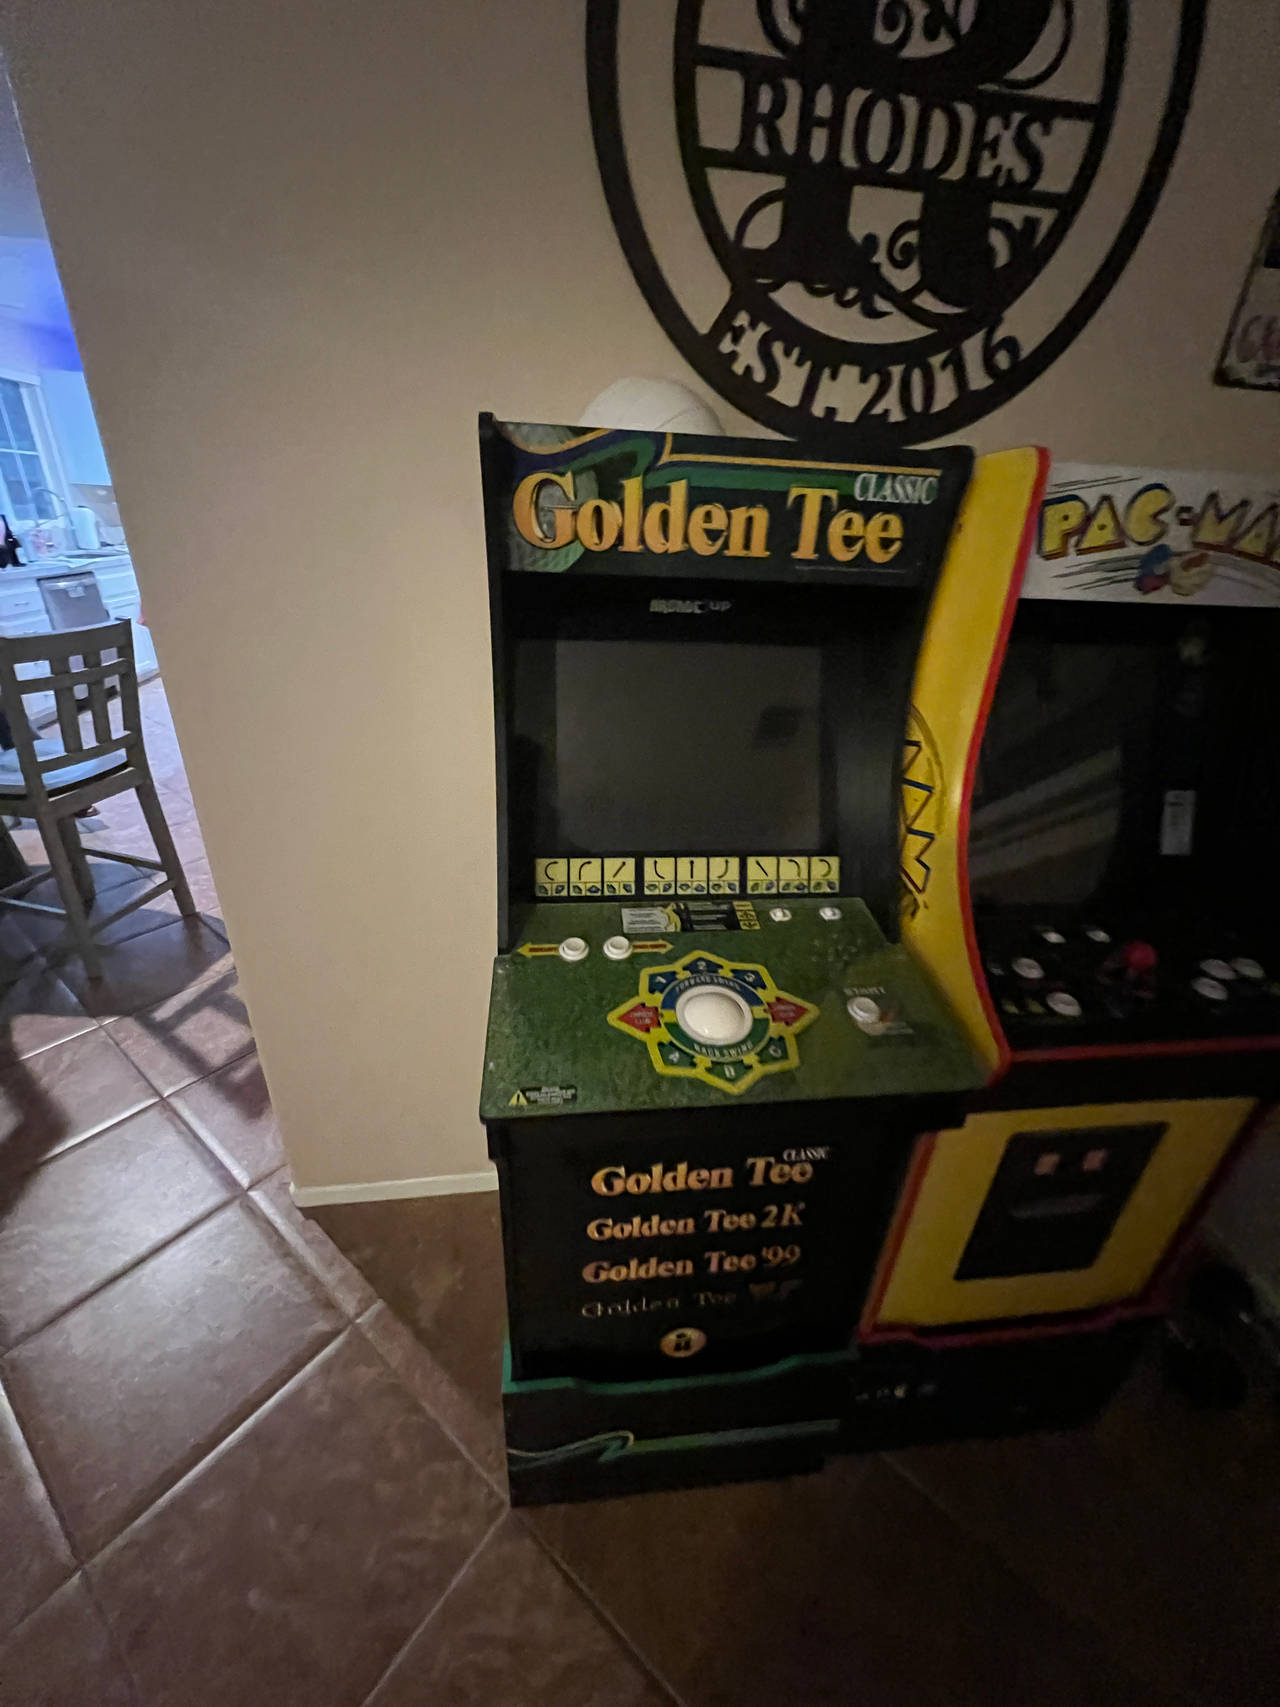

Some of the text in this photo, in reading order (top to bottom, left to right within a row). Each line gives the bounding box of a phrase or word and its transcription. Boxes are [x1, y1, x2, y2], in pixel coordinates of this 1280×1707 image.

[744, 72, 1050, 188] RHODES
[858, 322, 1022, 424] 2016
[511, 470, 905, 564] Golden Tee
[853, 471, 939, 506] CLASSIC
[1036, 482, 1280, 570] PAC-MA
[589, 1155, 816, 1198] Golden Tee
[585, 1200, 806, 1242] Golden Tee 2K
[581, 1256, 695, 1284] Golden
[703, 1249, 758, 1275] Tee
